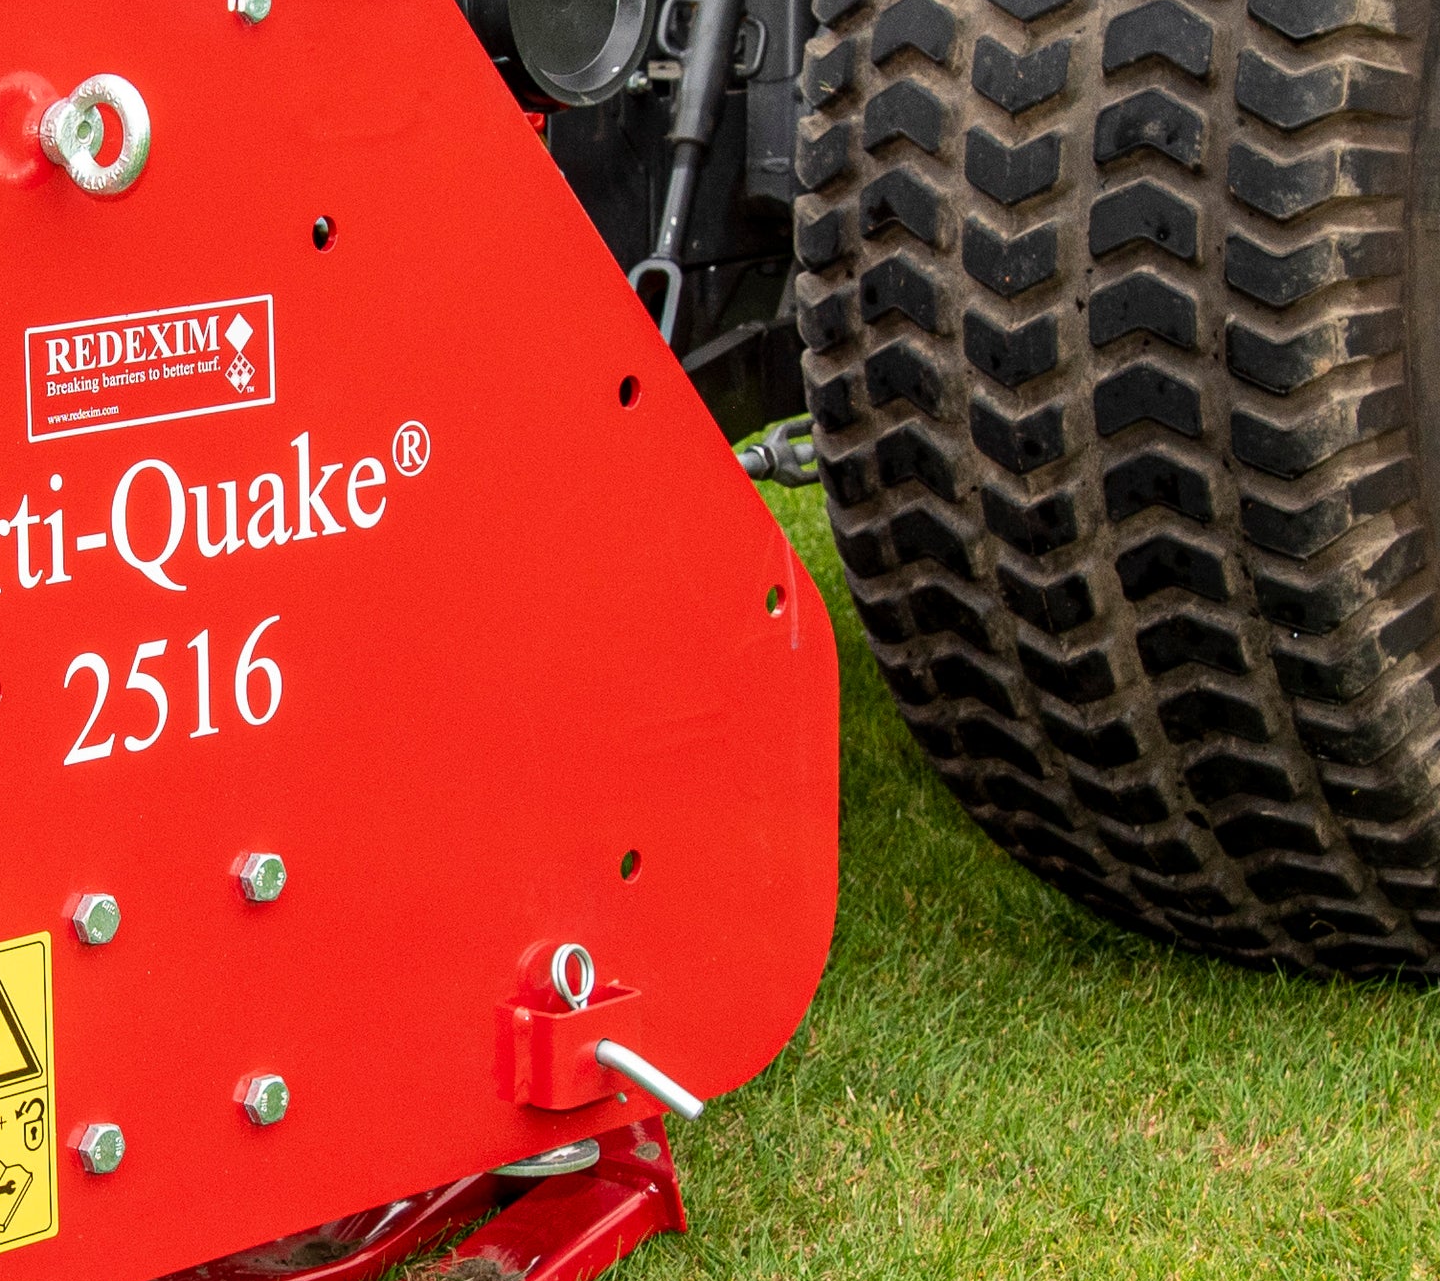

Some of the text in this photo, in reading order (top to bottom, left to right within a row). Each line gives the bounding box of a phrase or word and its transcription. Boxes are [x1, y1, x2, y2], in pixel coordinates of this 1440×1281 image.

[45, 315, 221, 376] REDEXIM
[46, 355, 221, 397] Breaking barriers to better turf.
[47, 405, 120, 426] www.redexim.com
[63, 614, 283, 766] 2516
